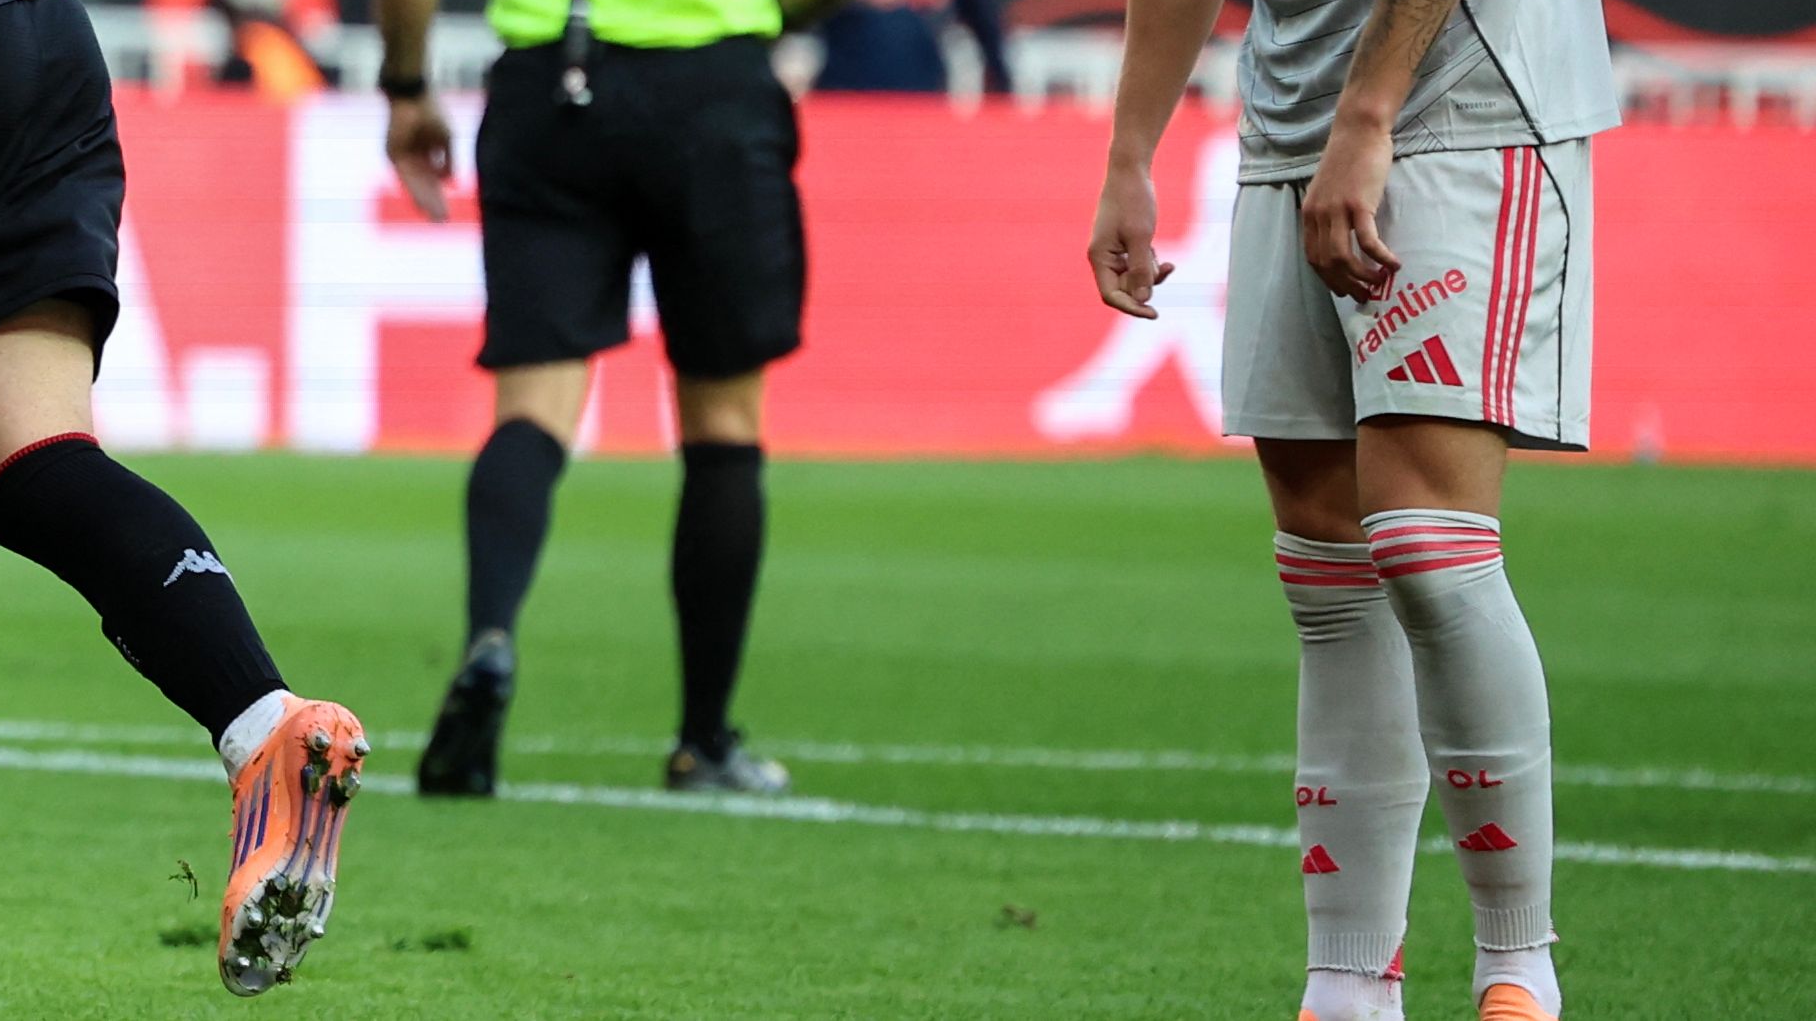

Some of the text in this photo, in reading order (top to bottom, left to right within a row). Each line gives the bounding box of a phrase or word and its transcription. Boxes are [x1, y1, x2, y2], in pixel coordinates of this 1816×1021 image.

[1356, 268, 1468, 370] rainline
[1446, 769, 1504, 790] OL
[1296, 786, 1338, 807] OL
